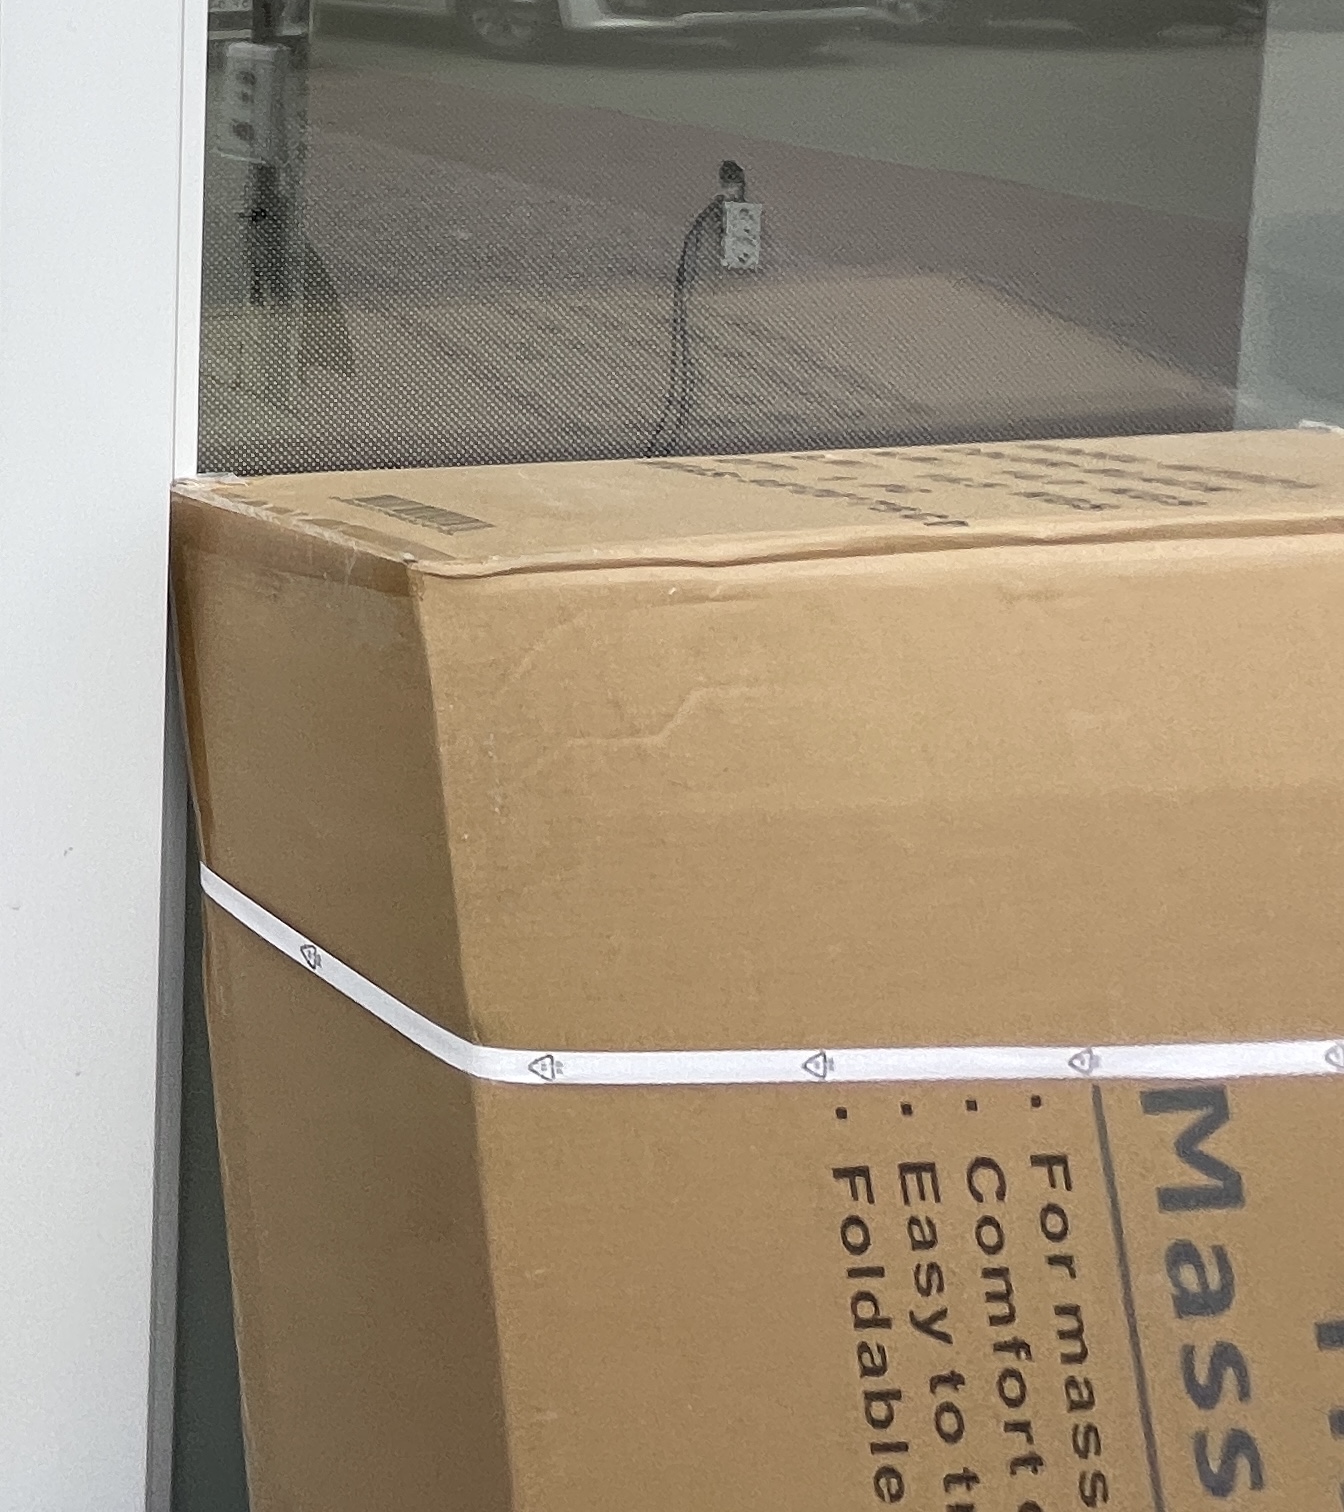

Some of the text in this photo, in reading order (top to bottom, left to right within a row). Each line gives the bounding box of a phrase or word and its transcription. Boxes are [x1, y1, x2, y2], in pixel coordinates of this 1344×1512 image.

[832, 1164, 910, 1503] Foldable
[897, 1161, 953, 1345] Easy
[929, 1369, 966, 1444] to
[966, 1156, 1044, 1476] Comfort
[1030, 1153, 1109, 1508] For mass
[1140, 1084, 1265, 1498] Mass
